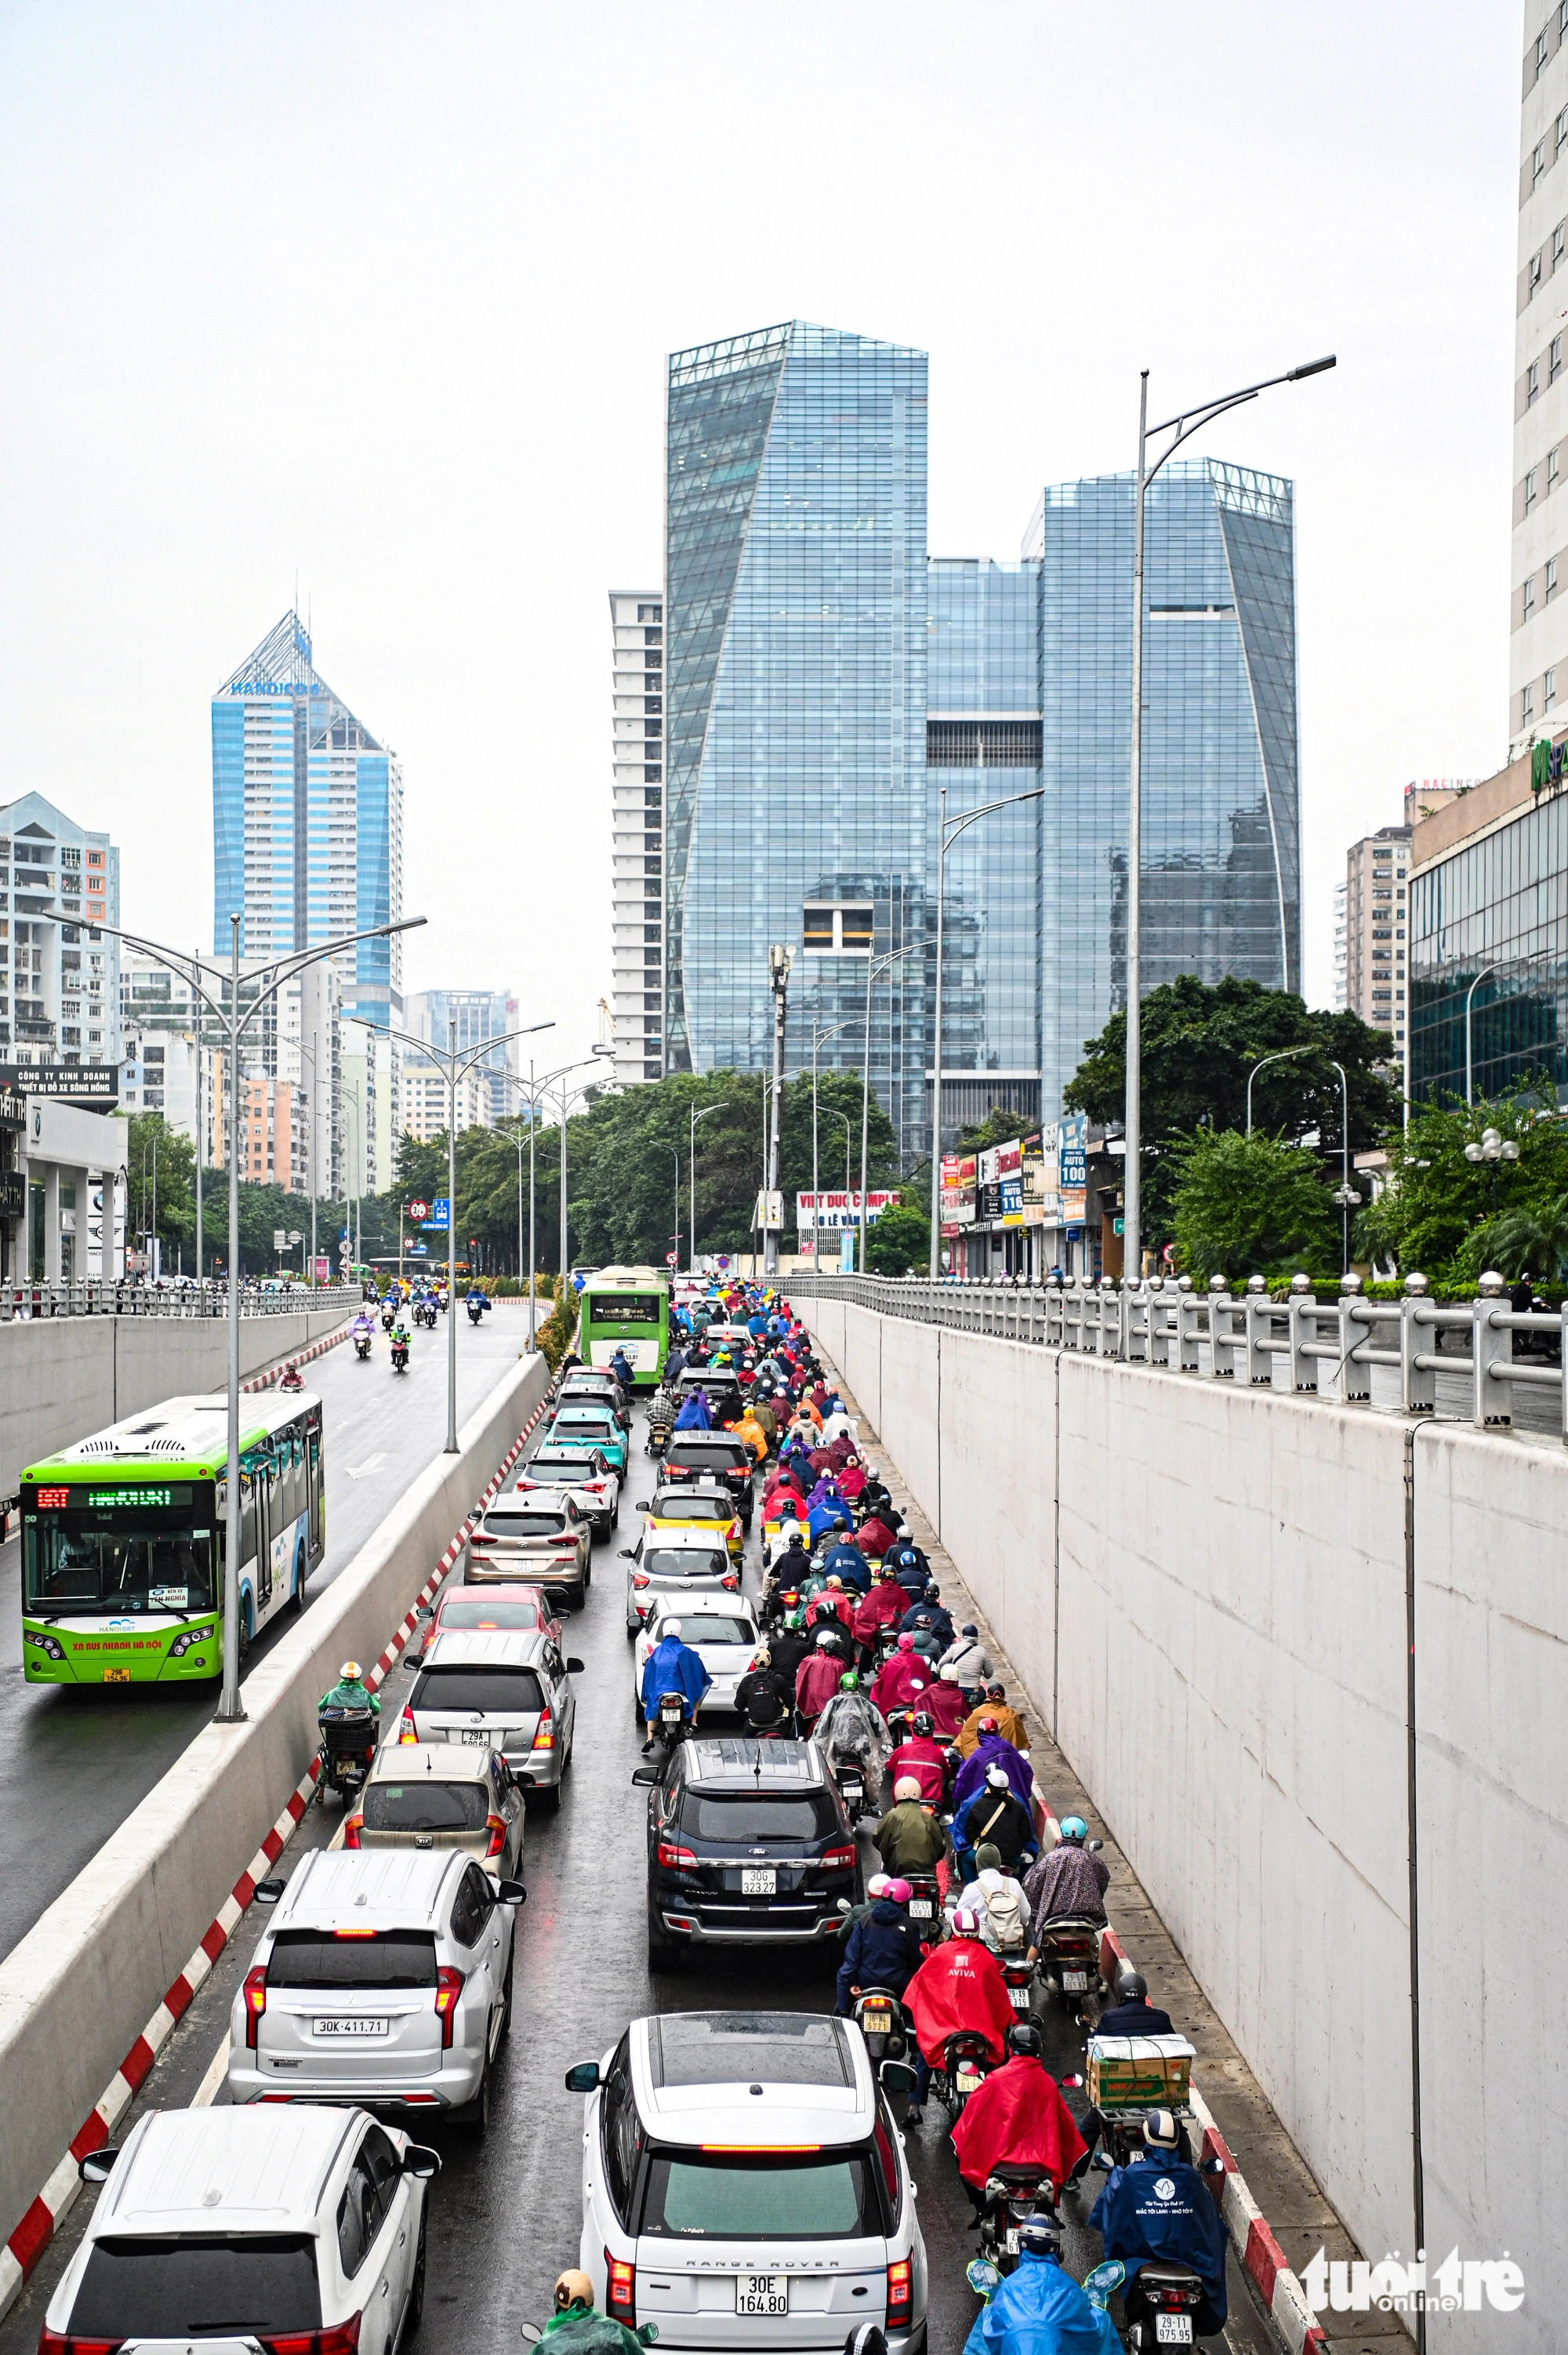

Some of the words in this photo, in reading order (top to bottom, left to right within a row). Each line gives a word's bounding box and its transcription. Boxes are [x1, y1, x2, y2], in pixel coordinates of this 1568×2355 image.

[231, 681, 307, 696] HANDICO
[18, 1070, 40, 1081] CÔNG
[45, 1072, 54, 1081] TY
[59, 1072, 78, 1081] KINH
[83, 1072, 110, 1081] DOANH
[18, 1081, 38, 1092] THIẾT
[59, 1083, 68, 1092] XE
[70, 1081, 89, 1092] SÔNG
[1064, 1156, 1084, 1165] AUTO
[1062, 1166, 1086, 1181] 100
[1004, 1187, 1021, 1196] AUTO
[1003, 1196, 1023, 1209] 116
[1025, 1207, 1044, 1218] 118
[829, 1213, 838, 1226] LÊ
[103, 1641, 131, 1650] NHANH
[133, 1640, 143, 1649] HÀ
[146, 1640, 162, 1650] NỘI
[469, 1732, 483, 1740] 29A
[750, 1871, 768, 1881] 30G
[743, 1882, 774, 1893] 323.27
[911, 1909, 931, 1917] 558.24
[948, 1968, 975, 1979] AVIVA
[1065, 1981, 1087, 1990] 065.62
[319, 2021, 381, 2032] 30K-411.71
[749, 2276, 776, 2294] 30E
[739, 2295, 786, 2313] 164.80
[1162, 2317, 1186, 2328] 29-T1
[1160, 2329, 1190, 2341] 975.95
